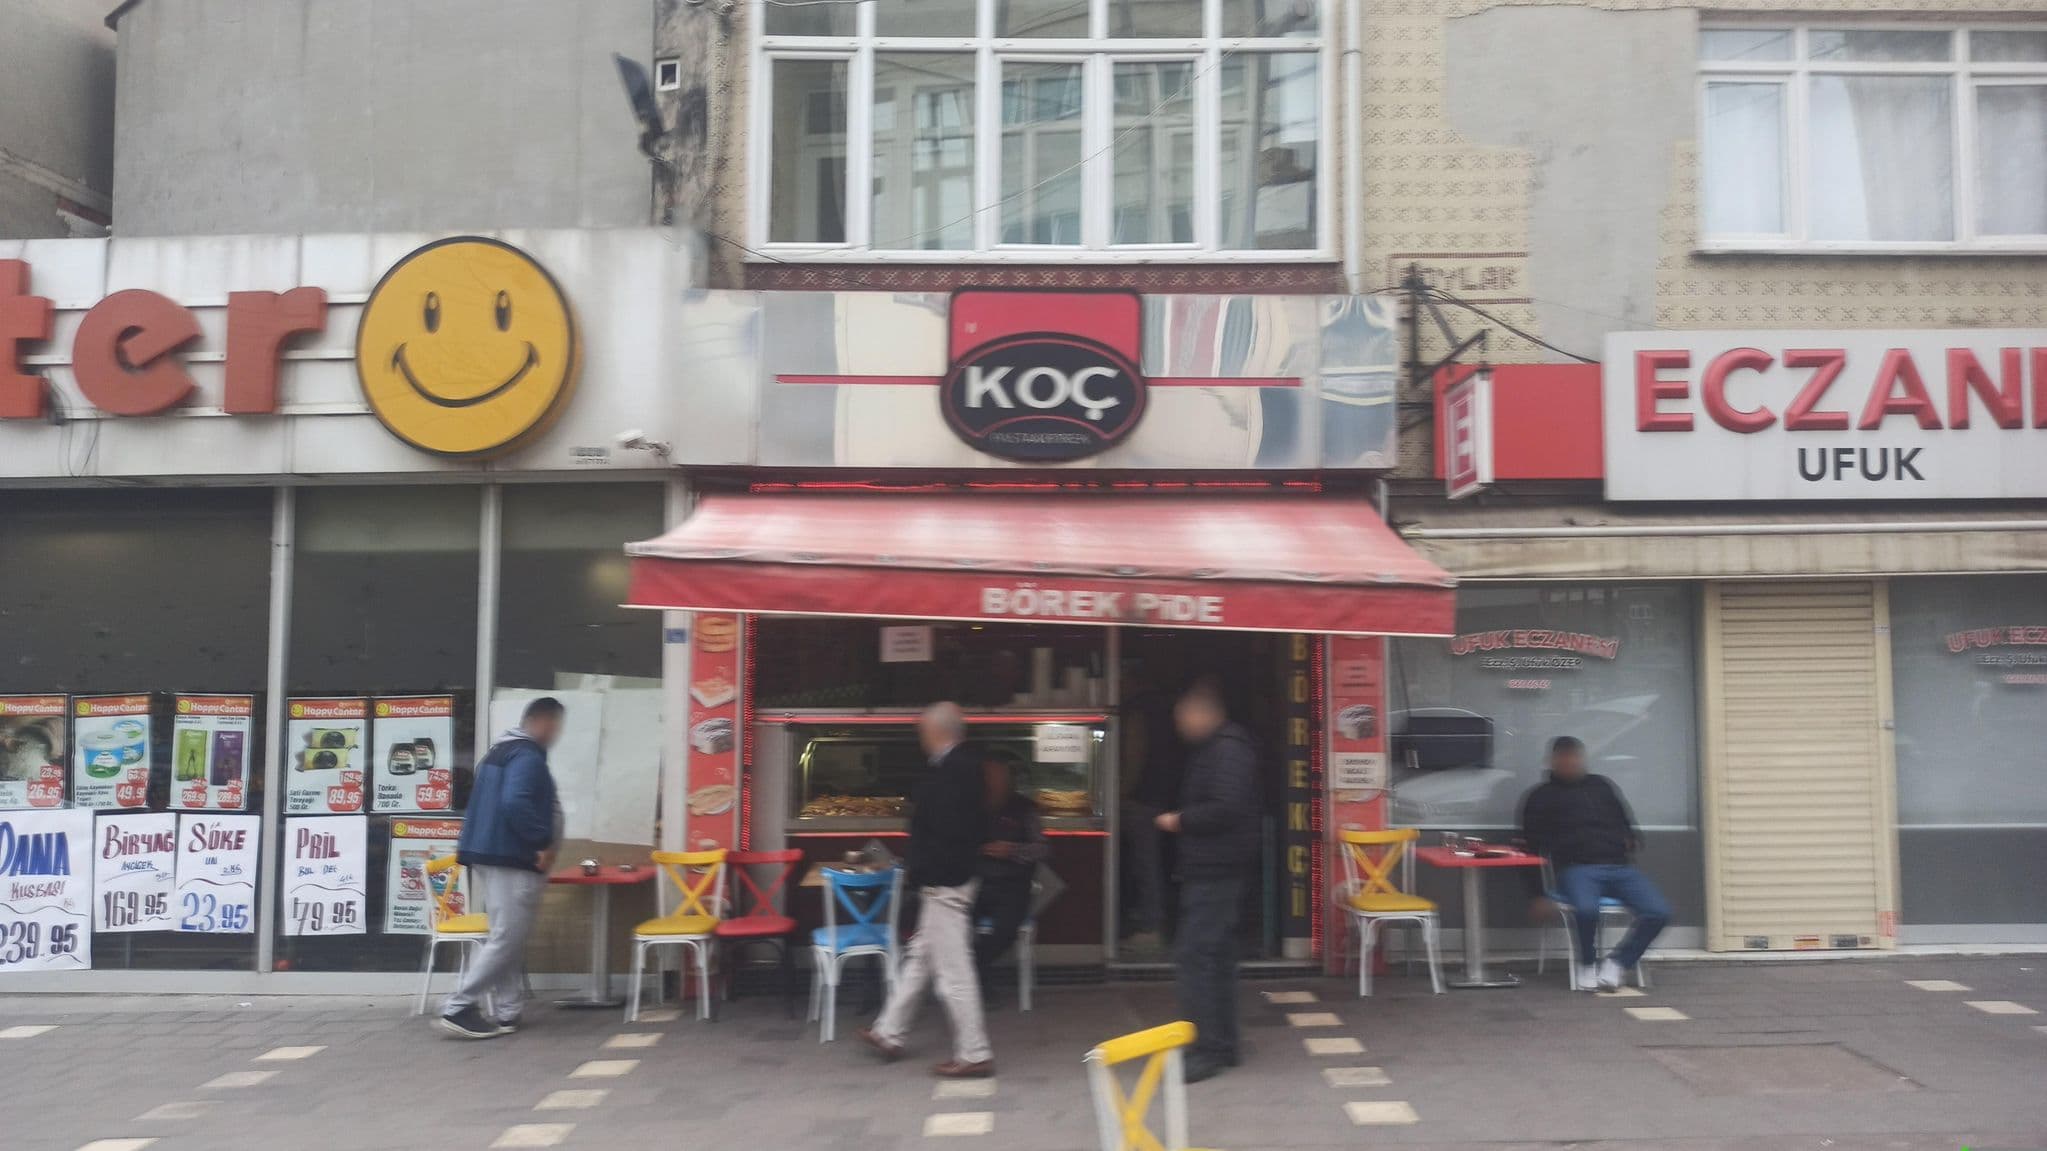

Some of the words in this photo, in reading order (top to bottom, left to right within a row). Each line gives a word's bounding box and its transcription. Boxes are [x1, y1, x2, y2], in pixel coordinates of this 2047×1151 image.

[964, 366, 1121, 421] KOÇ
[1634, 346, 2047, 434] ECZAN
[1797, 447, 1926, 482] UFUK
[983, 582, 1125, 618] BÖREK
[1451, 631, 1511, 656] UFUK
[0, 821, 71, 876] DANA
[188, 822, 247, 853] SÖKE
